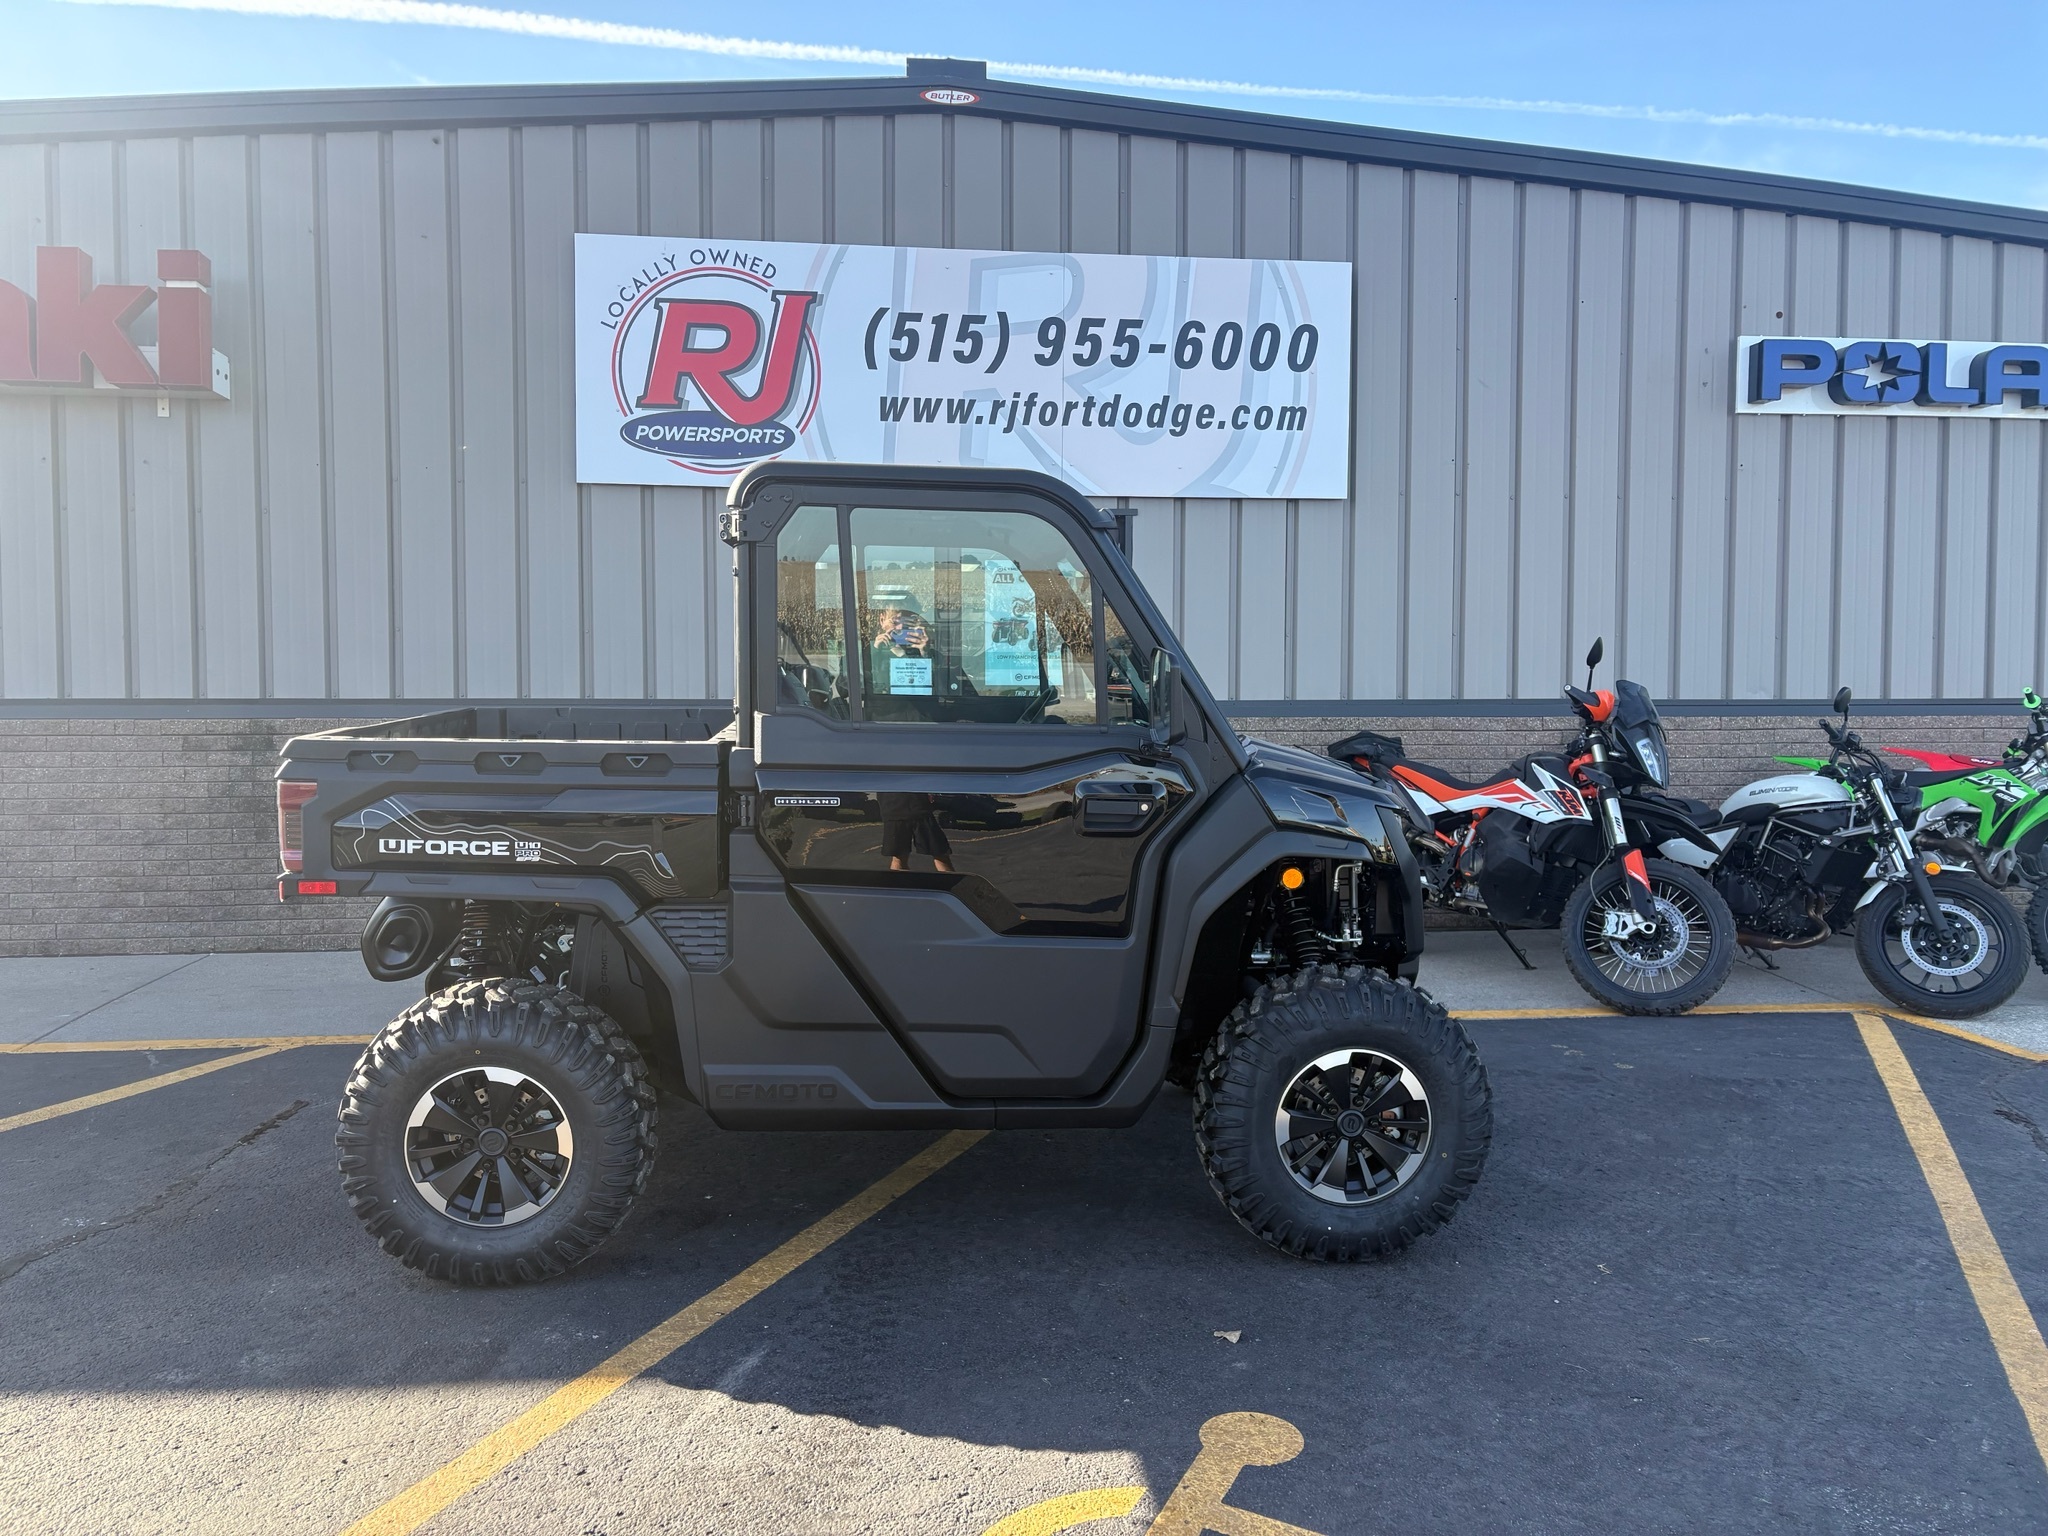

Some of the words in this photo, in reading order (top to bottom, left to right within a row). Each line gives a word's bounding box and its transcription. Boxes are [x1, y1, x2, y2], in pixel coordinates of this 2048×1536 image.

[930, 92, 971, 101] BUTLER
[600, 253, 677, 330] LOCALLY
[690, 248, 777, 279] OWNED
[864, 307, 1011, 374] (515)
[1034, 316, 1319, 373] 955-6000
[635, 290, 820, 426] RJ
[879, 392, 1308, 438] www.rjfortdodge.com
[635, 424, 786, 445] POWERSPORTS
[1556, 790, 1584, 816] KTM
[379, 838, 510, 856] UFORCE
[515, 841, 541, 849] U10
[515, 849, 541, 857] PRO
[715, 1083, 838, 1100] CFMOTO
